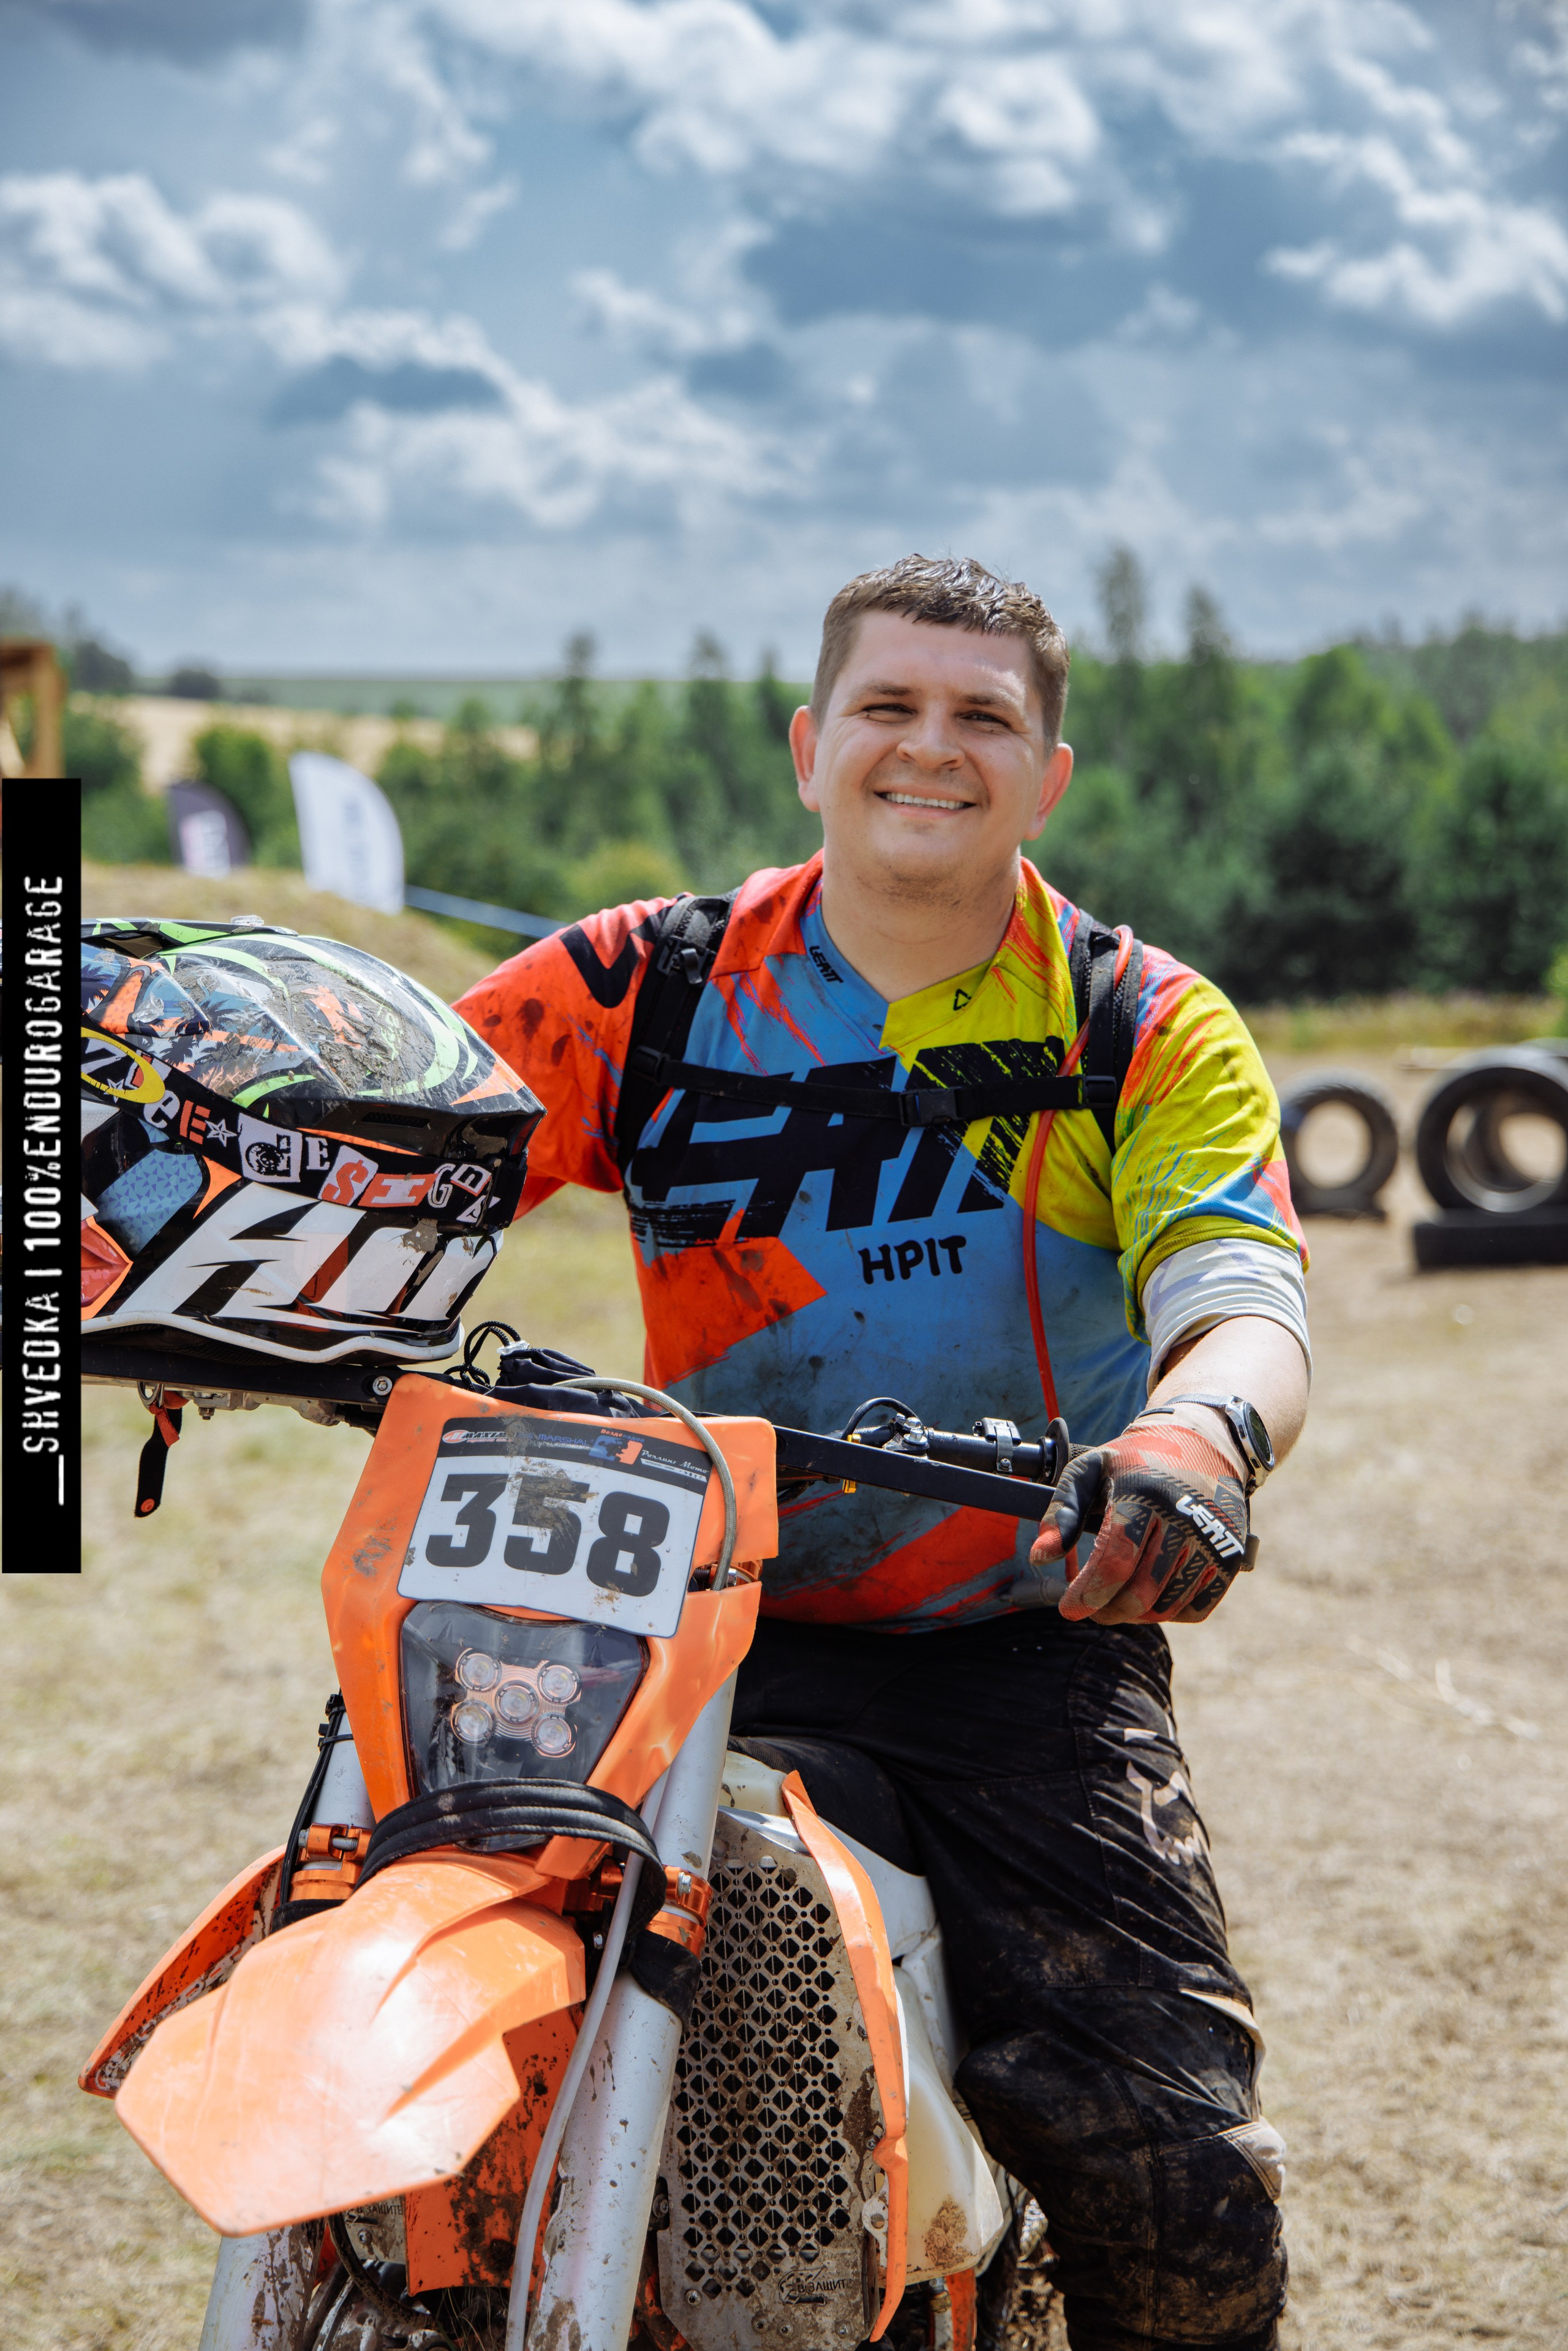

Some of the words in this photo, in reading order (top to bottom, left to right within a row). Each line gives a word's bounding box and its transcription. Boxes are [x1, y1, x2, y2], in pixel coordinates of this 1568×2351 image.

[809, 946, 844, 983] LEATT
[630, 1036, 1066, 1247] EATT
[858, 1235, 967, 1285] HPIT
[538, 1433, 590, 1446] MARSHAL
[425, 1473, 671, 1598] 358
[1175, 1495, 1245, 1558] LEATT
[807, 2278, 851, 2294] ЗАЩИТ
